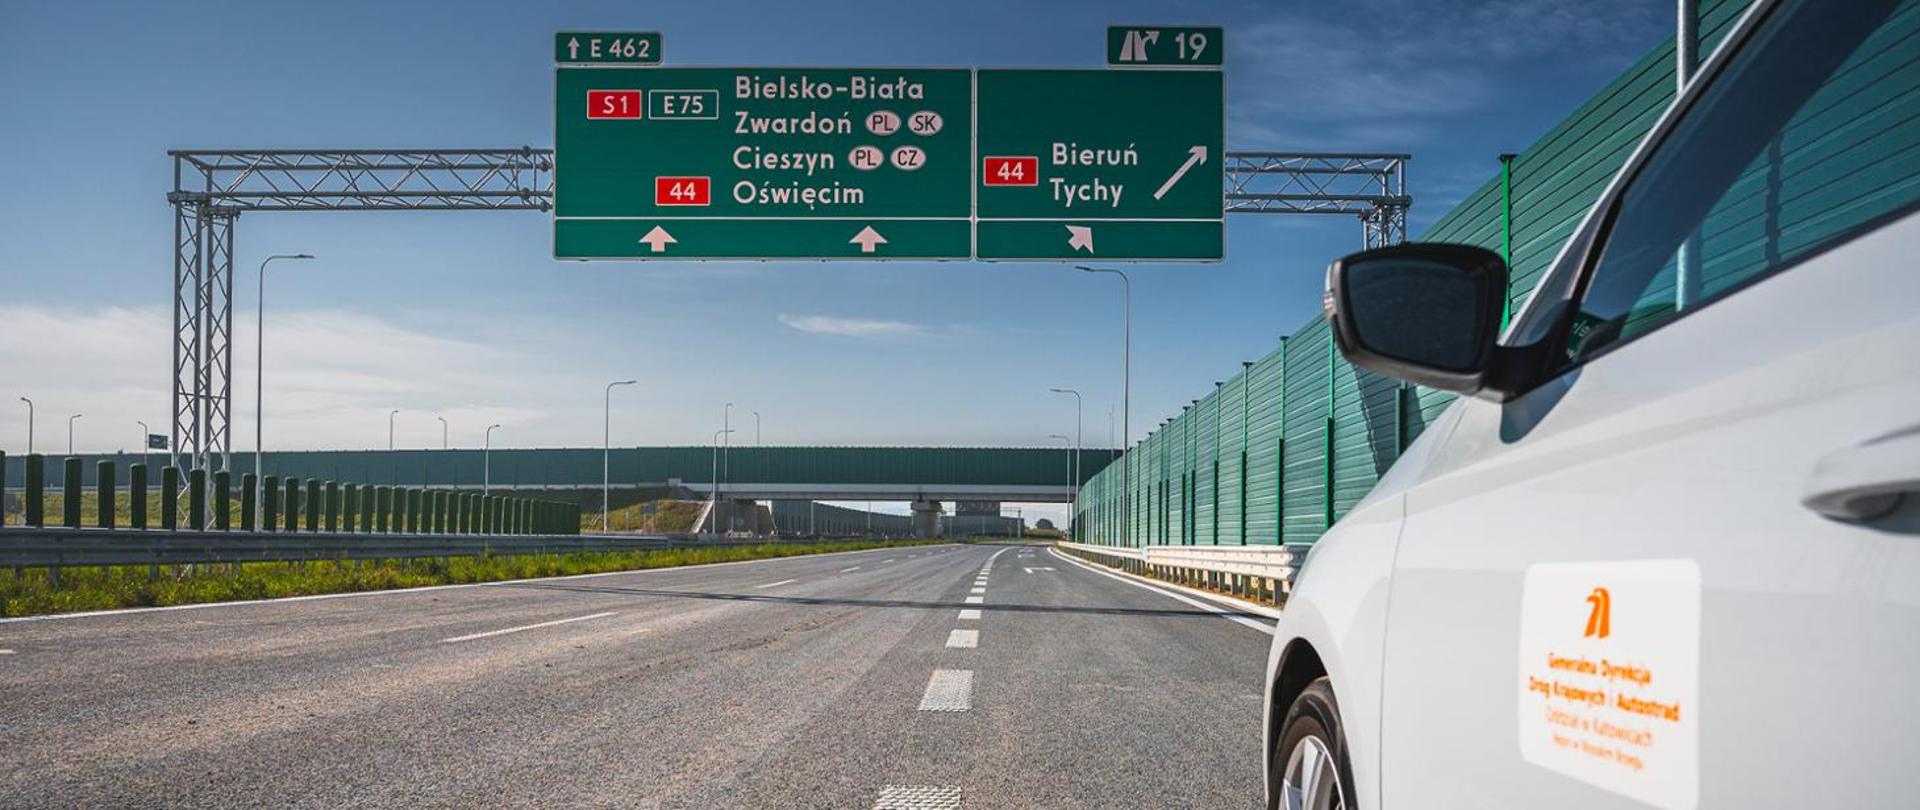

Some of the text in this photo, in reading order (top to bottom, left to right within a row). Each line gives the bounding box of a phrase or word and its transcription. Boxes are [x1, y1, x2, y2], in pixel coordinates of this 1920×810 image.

[590, 39, 650, 57] E 462
[1175, 32, 1207, 60] 19
[735, 75, 924, 100] Bielsko-Biała
[679, 95, 704, 114] 75
[735, 111, 852, 134] Zwardoń
[872, 115, 893, 131] PL
[914, 115, 936, 131] SK
[733, 145, 834, 176] Cieszyn
[855, 150, 876, 166] PL
[897, 150, 918, 166] CZ
[1052, 142, 1138, 166] Bieruń
[997, 161, 1025, 181] 44
[669, 182, 697, 201] 44
[733, 180, 864, 209] Oświęcim
[1050, 178, 1123, 207] Tychy
[1548, 651, 1652, 688] Generalna Dyrekcja
[1616, 693, 1680, 722] Autostrad
